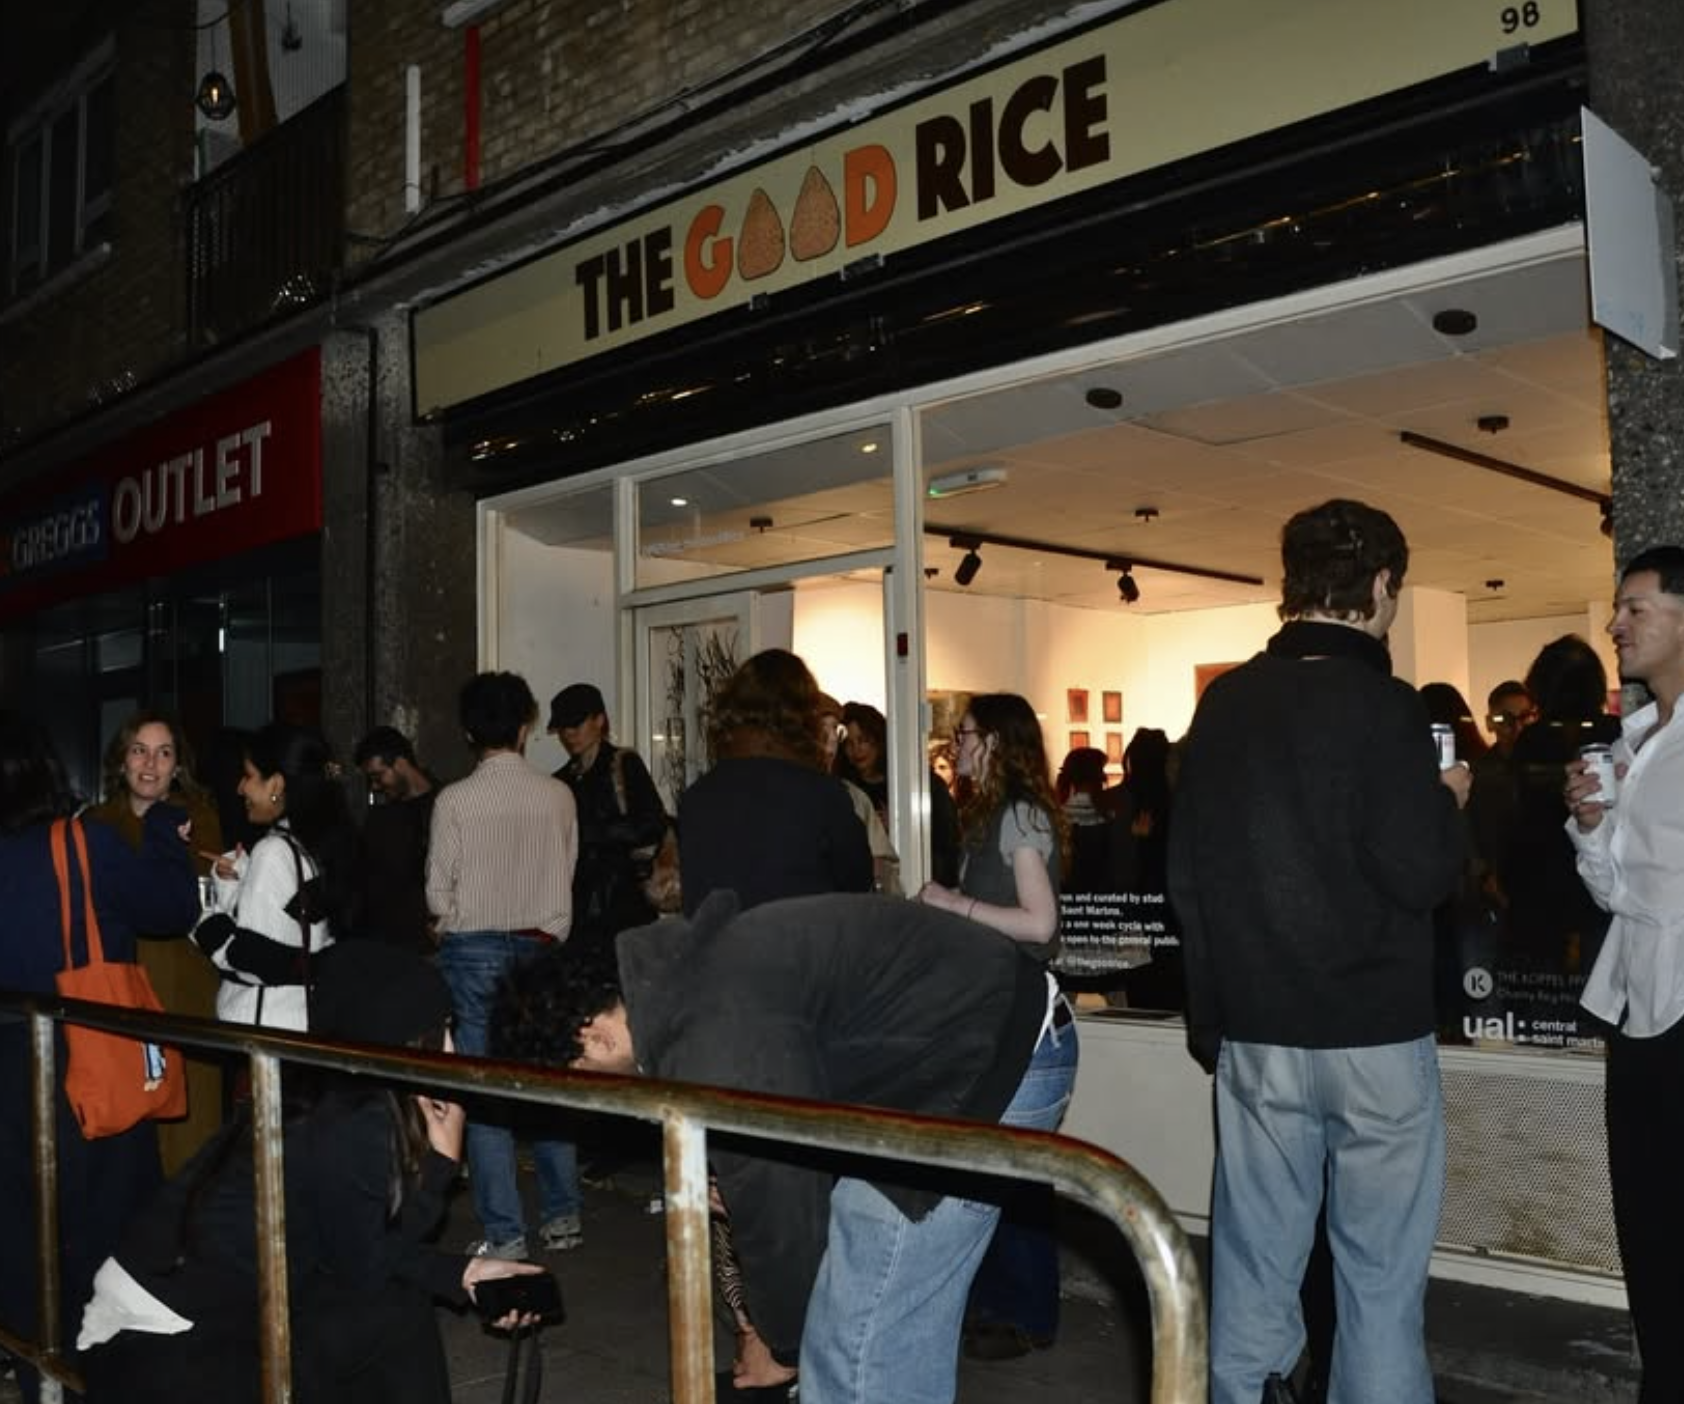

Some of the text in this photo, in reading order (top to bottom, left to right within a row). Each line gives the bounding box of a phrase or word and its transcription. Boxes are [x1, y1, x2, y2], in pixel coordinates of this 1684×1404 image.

[1501, 1, 1540, 34] 98
[575, 224, 675, 341] THE
[915, 54, 1110, 222] RICE
[11, 420, 271, 571] GREGGS OUTLET
[1094, 892, 1127, 903] curated
[1129, 892, 1140, 905] by
[1142, 892, 1165, 904] stud
[1092, 920, 1116, 931] week
[1118, 921, 1142, 932] cycle
[1144, 921, 1165, 932] with
[1462, 1011, 1526, 1043] ual:
[1532, 1019, 1577, 1033] central
[1532, 1034, 1564, 1047] saint
